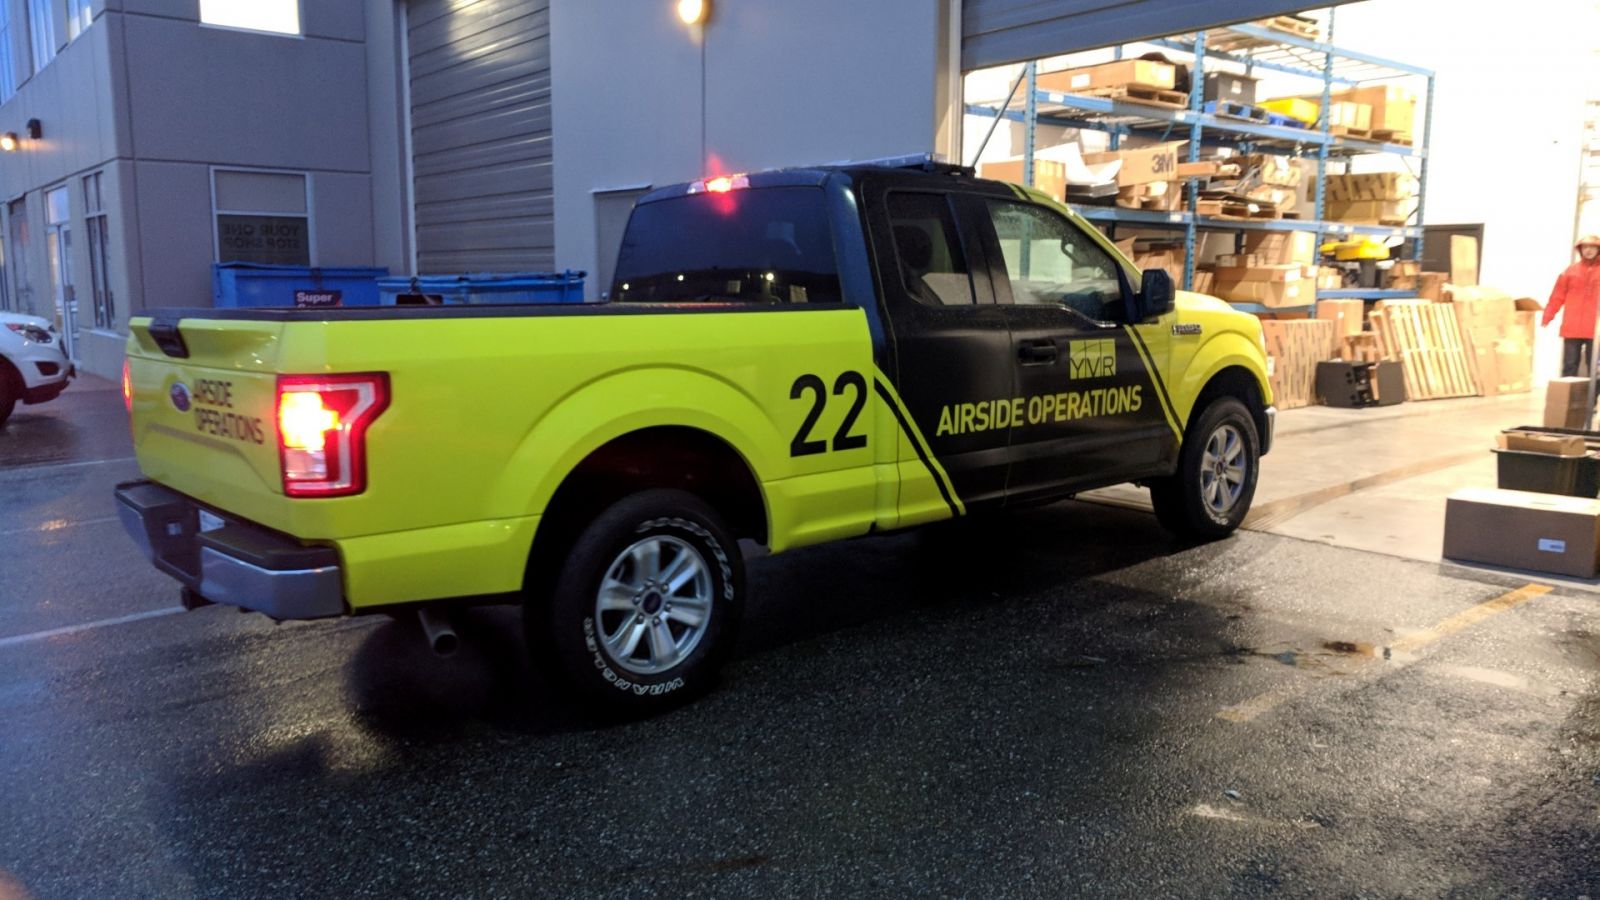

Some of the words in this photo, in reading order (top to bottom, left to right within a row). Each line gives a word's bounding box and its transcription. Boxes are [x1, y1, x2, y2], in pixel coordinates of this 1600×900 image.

[1152, 153, 1174, 174] 3M
[296, 291, 333, 304] Super
[789, 370, 868, 458] 22
[936, 398, 1025, 437] AIRSIDE
[1027, 384, 1143, 425] OPERATIONS
